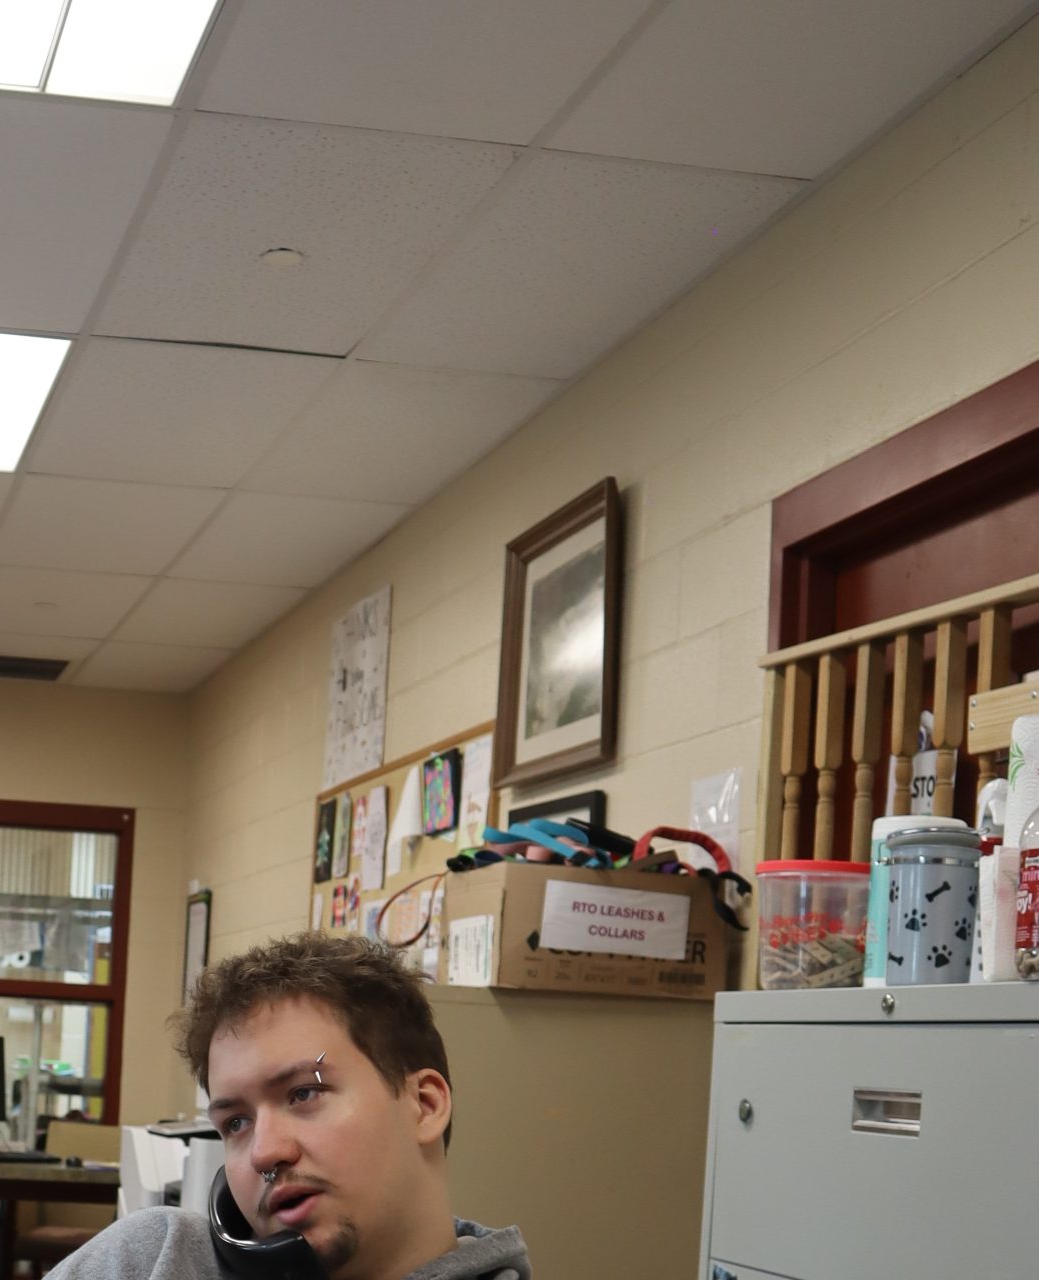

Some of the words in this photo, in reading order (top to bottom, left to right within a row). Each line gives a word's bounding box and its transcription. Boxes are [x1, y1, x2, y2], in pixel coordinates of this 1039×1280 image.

[911, 774, 938, 798] STO
[572, 901, 598, 914] RTO
[600, 904, 655, 921] LEASHES
[657, 911, 665, 922] &
[588, 924, 646, 941] COLLARS
